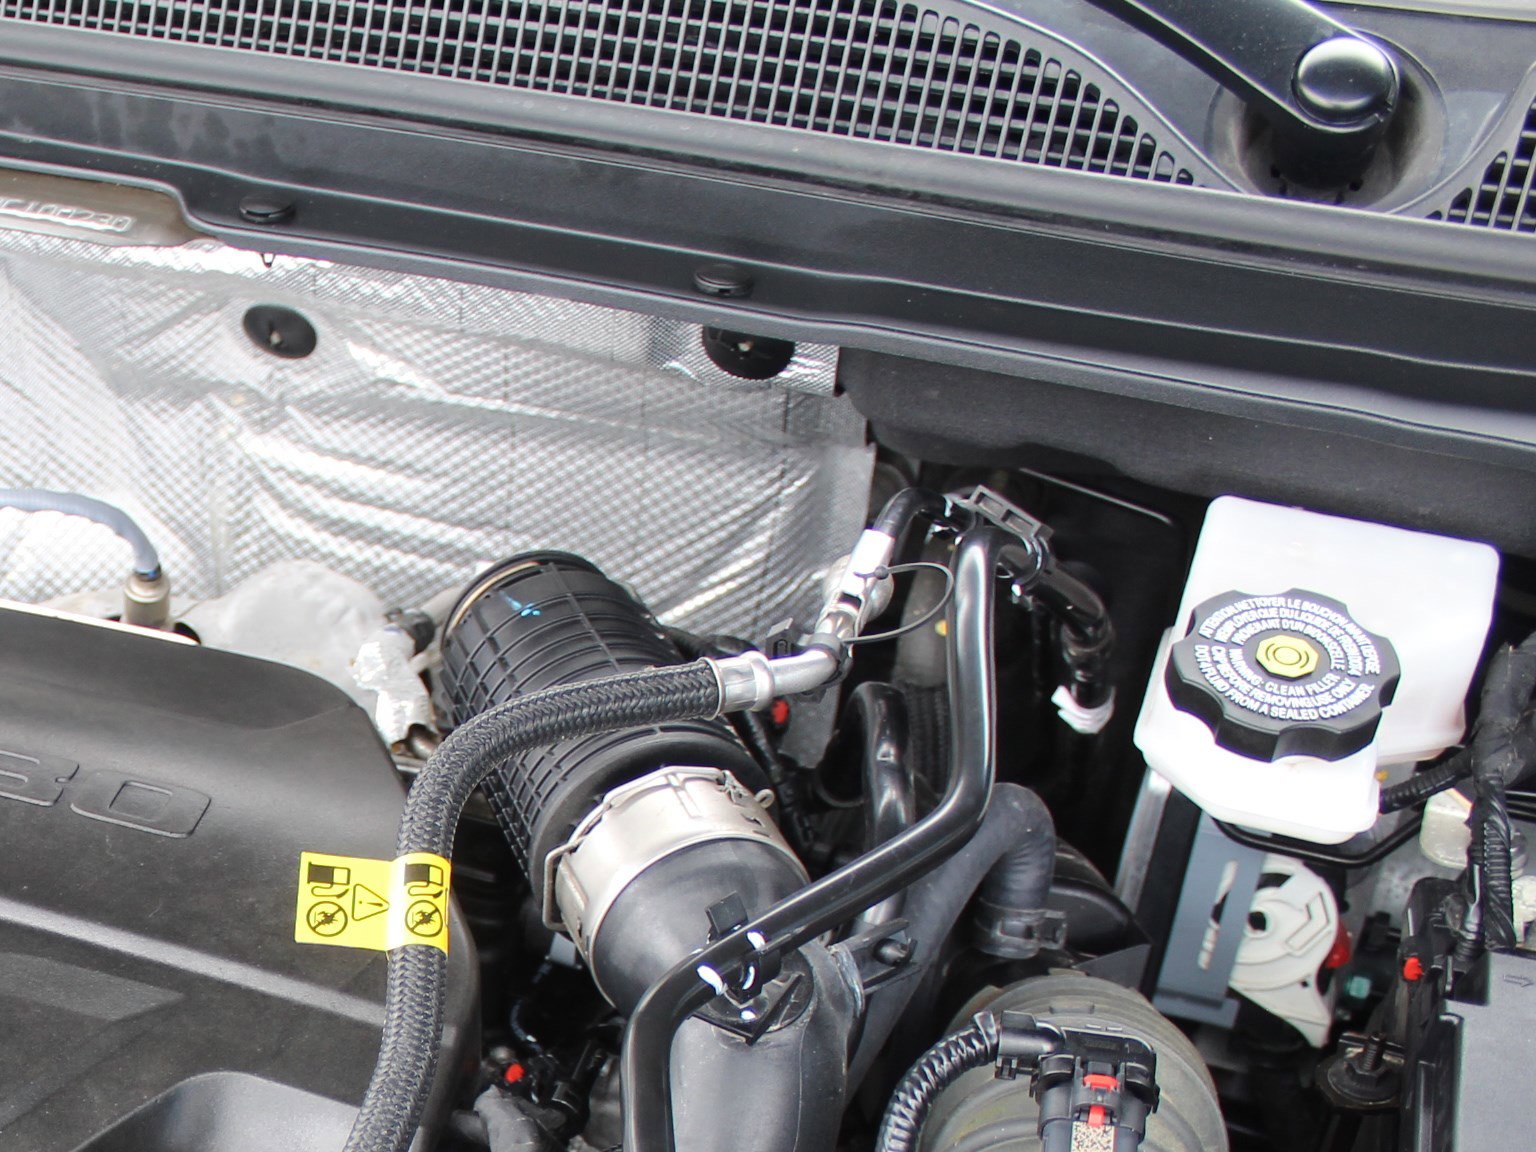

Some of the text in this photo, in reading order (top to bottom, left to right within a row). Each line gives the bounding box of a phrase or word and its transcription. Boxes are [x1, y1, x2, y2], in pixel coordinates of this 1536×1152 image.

[1261, 680, 1307, 696] CLEAN
[1303, 671, 1341, 695] FILLER
[1221, 687, 1261, 711] FROM
[1257, 703, 1270, 715] A
[1268, 705, 1321, 719] SEALED
